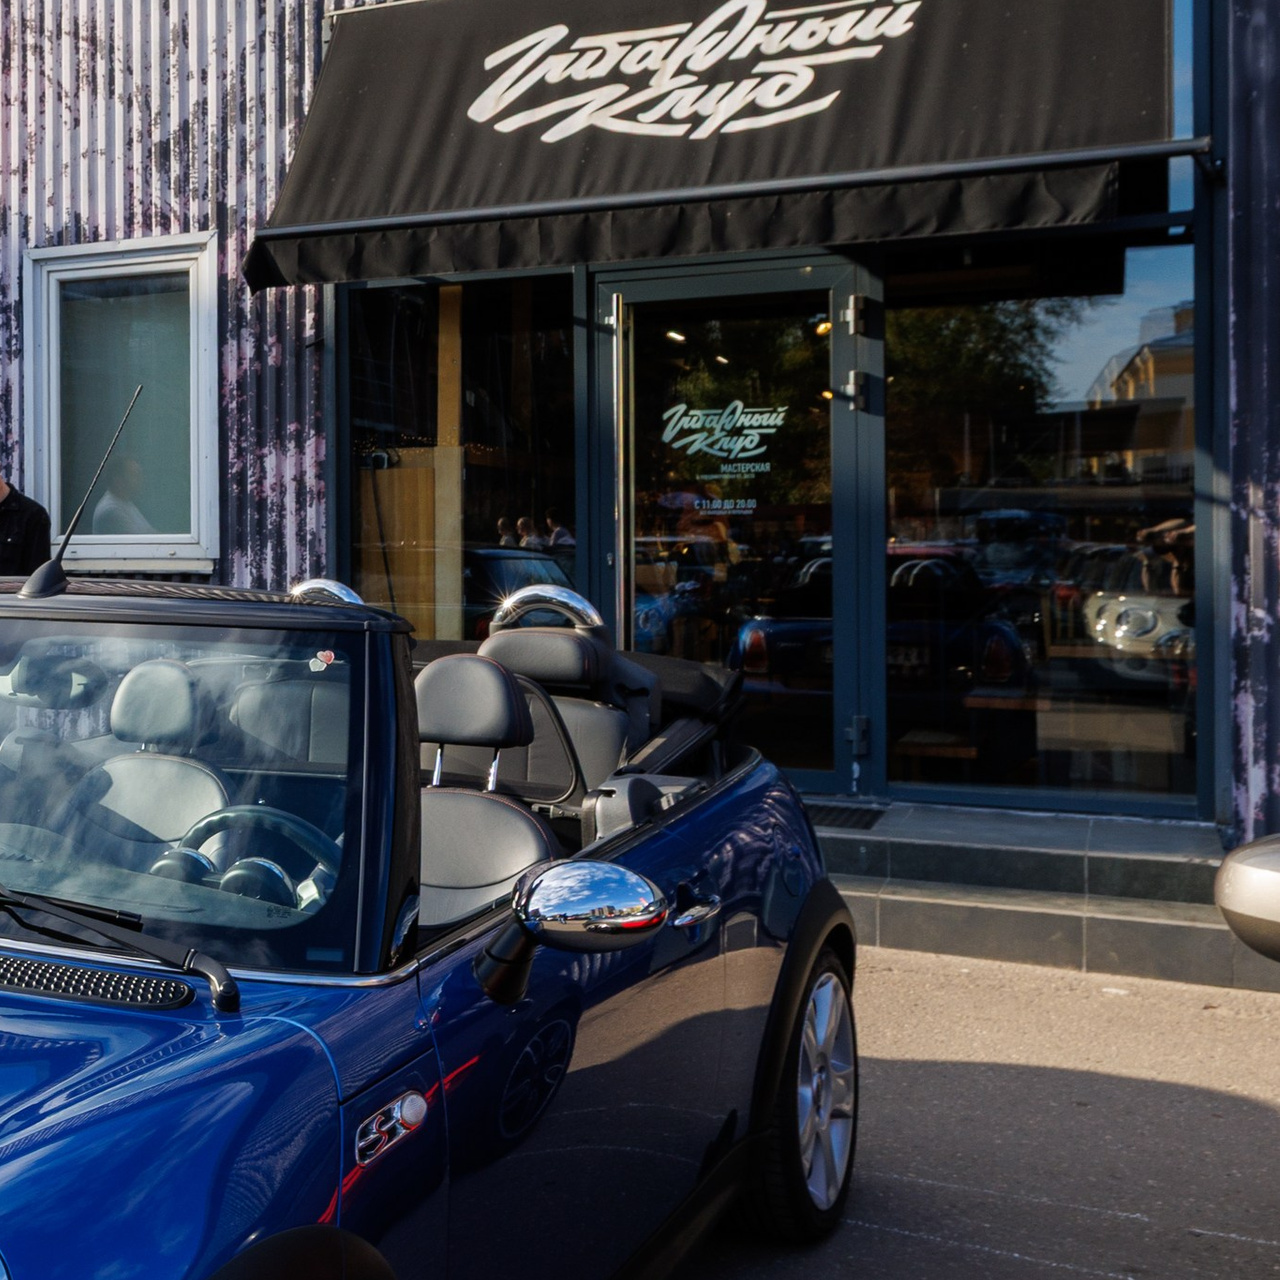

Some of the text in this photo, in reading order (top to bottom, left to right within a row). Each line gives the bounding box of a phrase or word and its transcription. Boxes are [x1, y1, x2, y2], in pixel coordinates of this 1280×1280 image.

[493, 45, 883, 143] Клуб
[662, 400, 789, 443] Гитарный
[672, 428, 777, 459] Клуб
[720, 462, 771, 473] МАСТЕРСКАЯ
[723, 500, 735, 509] ДО
